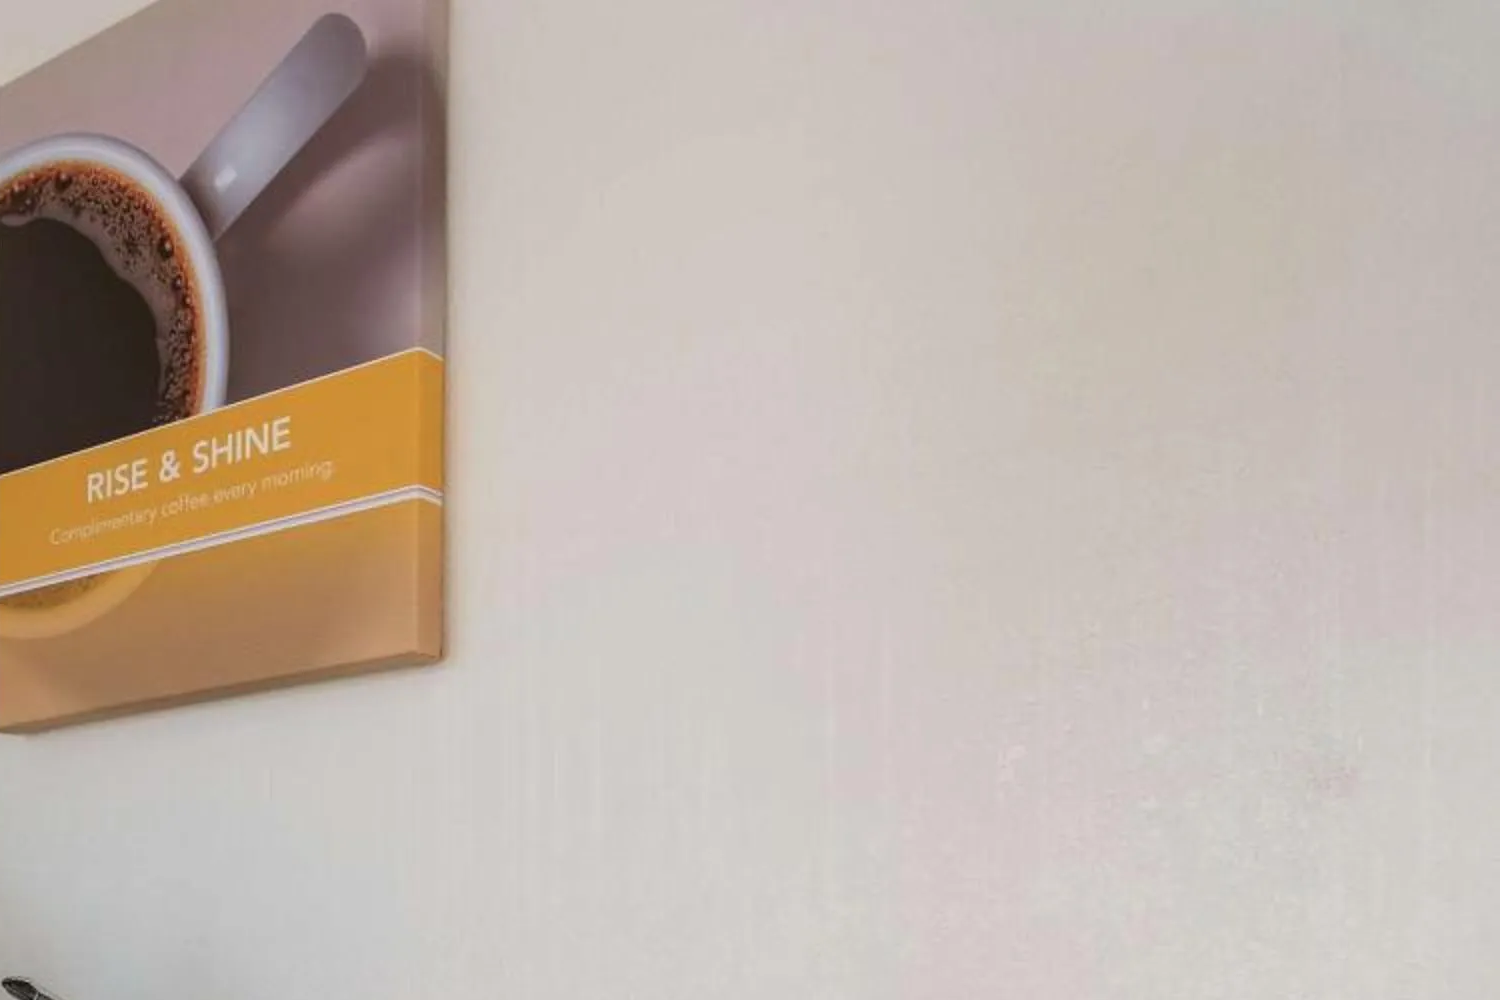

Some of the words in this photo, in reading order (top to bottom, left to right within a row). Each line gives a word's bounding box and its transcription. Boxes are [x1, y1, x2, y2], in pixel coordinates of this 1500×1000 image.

[87, 458, 148, 503] RISE
[159, 449, 180, 482] &
[192, 415, 291, 474] SHINE
[50, 507, 158, 545] Complimentary
[161, 493, 209, 518] coffee
[213, 481, 257, 502] every
